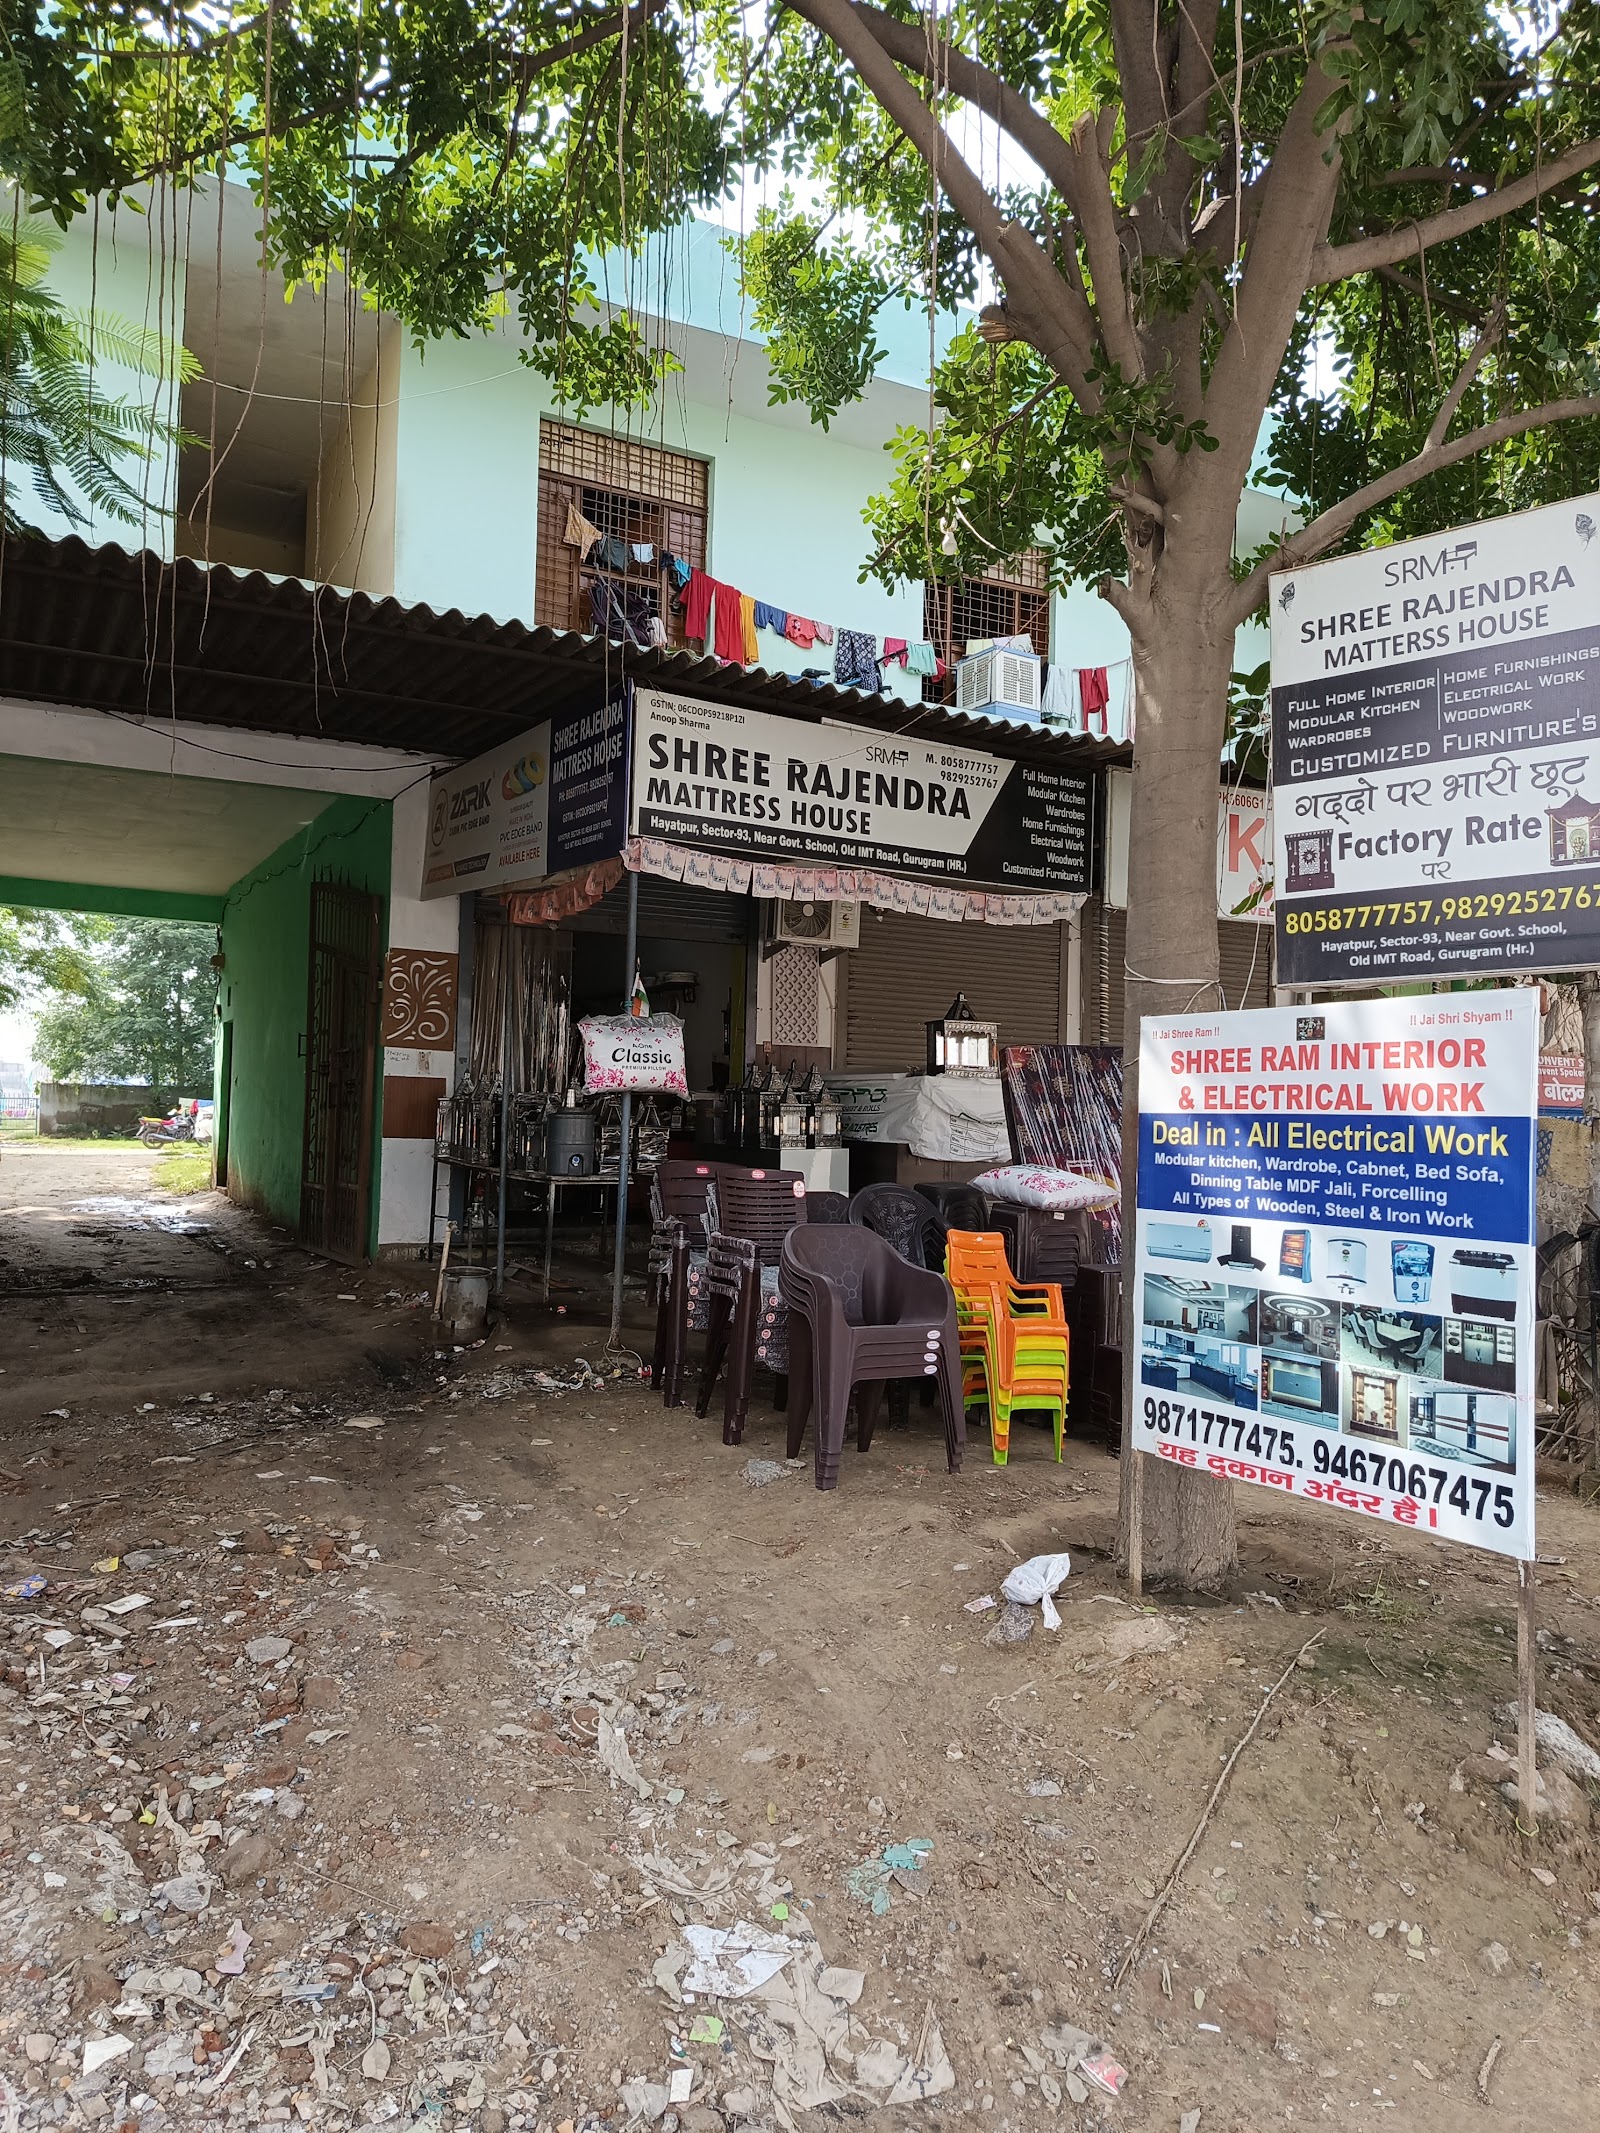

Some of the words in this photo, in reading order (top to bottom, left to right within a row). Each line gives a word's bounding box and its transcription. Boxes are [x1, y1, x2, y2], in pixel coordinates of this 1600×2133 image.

[1300, 604, 1391, 643] SHREE
[1403, 566, 1575, 622] RAJENDRA
[1324, 625, 1449, 669] MATTERSS
[1459, 605, 1548, 642] HOUSE
[651, 699, 676, 711] GSTIN:
[554, 722, 578, 753] SHREE
[580, 700, 623, 742] RAJENDRA
[650, 712, 676, 725] Anoop
[679, 717, 710, 730] Sharma
[553, 747, 592, 784] MATTRESS
[594, 733, 622, 766] HOUSE
[926, 753, 937, 764] M.
[941, 756, 998, 774] 8058777757
[649, 734, 770, 787] SHREE
[787, 758, 971, 820] RAJENDRA
[940, 771, 998, 789] 9829252767
[1023, 769, 1035, 781] Full
[1038, 772, 1058, 785] Home
[1060, 775, 1086, 789] Interior
[1387, 779, 1432, 807] पर
[1443, 757, 1521, 801] भारी
[1530, 756, 1589, 797] छूट
[647, 777, 780, 821] MATTRESS
[792, 801, 870, 835] HOUSE
[1028, 786, 1057, 800] Modular
[1059, 791, 1085, 805] Kitchen
[1022, 818, 1043, 830] Home
[1045, 820, 1084, 836] Furnishings
[1046, 805, 1085, 820] Wardrobes
[651, 816, 699, 836] Hayatpur,
[702, 823, 751, 843] Sector-93,
[754, 832, 777, 845] Near
[779, 835, 802, 849] Govt.
[805, 840, 838, 857] School,
[841, 845, 855, 856] Old
[858, 845, 874, 858] IMT
[877, 850, 900, 864] Road,
[903, 855, 944, 871] Gurugram
[947, 860, 967, 873] (HR.)
[1031, 834, 1063, 849] Electrical
[1065, 839, 1084, 851] Work
[1338, 828, 1453, 860] Factory
[1466, 814, 1542, 845] Rate
[526, 847, 540, 860] HERE
[1047, 852, 1084, 867] Woodwork
[1003, 862, 1044, 878] Customized
[1046, 867, 1084, 882] Furniture's
[1422, 861, 1451, 879] पर
[1321, 938, 1377, 952] Hayatpur,
[1380, 933, 1441, 948] Sector-93,
[1445, 930, 1476, 942] Near
[1479, 928, 1514, 939] Govt.
[1518, 922, 1567, 936] School,
[1349, 955, 1370, 966] Old
[1373, 953, 1396, 964] IMT
[1400, 951, 1434, 964] Road,
[1438, 945, 1502, 962] Gurugram
[1506, 942, 1535, 957] (Hr.)
[1159, 1030, 1171, 1039] Jai
[1172, 1028, 1193, 1038] Shree
[1195, 1027, 1212, 1037] Ram
[1420, 1014, 1435, 1025] Jai
[1438, 1012, 1460, 1024] Shri
[1463, 1011, 1501, 1025] Shyam
[612, 1048, 671, 1063] Classic
[1171, 1047, 1251, 1074] SHREE
[1262, 1044, 1319, 1070] RAM
[1331, 1039, 1486, 1069] INTERIOR
[1179, 1085, 1195, 1109] &
[1204, 1084, 1372, 1111] ELECTRICAL
[1383, 1082, 1485, 1112] WORK
[1152, 1121, 1198, 1145] Deal
[1207, 1126, 1225, 1146] in
[1247, 1122, 1278, 1147] All
[1288, 1123, 1414, 1152] Electrical
[1425, 1125, 1509, 1156] Work
[1155, 1153, 1205, 1167] Modular
[1209, 1154, 1262, 1171] kitchen,
[1265, 1157, 1342, 1175] Wardrobe,
[1347, 1161, 1409, 1179] Cabnet,
[1415, 1164, 1450, 1180] Bed
[1455, 1165, 1504, 1185] Sofa,
[1191, 1173, 1241, 1193] Dinning
[1245, 1177, 1282, 1192] Table
[1287, 1179, 1320, 1194] MDF
[1325, 1181, 1356, 1198] Jali,
[1362, 1183, 1447, 1206] Forcelling
[1173, 1192, 1190, 1204] All
[1191, 1193, 1231, 1209] Types
[1235, 1196, 1250, 1209] of
[1256, 1198, 1320, 1218] Wooden,
[1325, 1203, 1364, 1219] Steel
[1370, 1206, 1381, 1221] &
[1387, 1207, 1421, 1224] Iron
[1425, 1210, 1474, 1229] Work
[1158, 1440, 1198, 1463] यह
[1207, 1452, 1295, 1490] दुकान
[1303, 1479, 1381, 1514] अंदर
[1314, 1439, 1514, 1527] 9467067475
